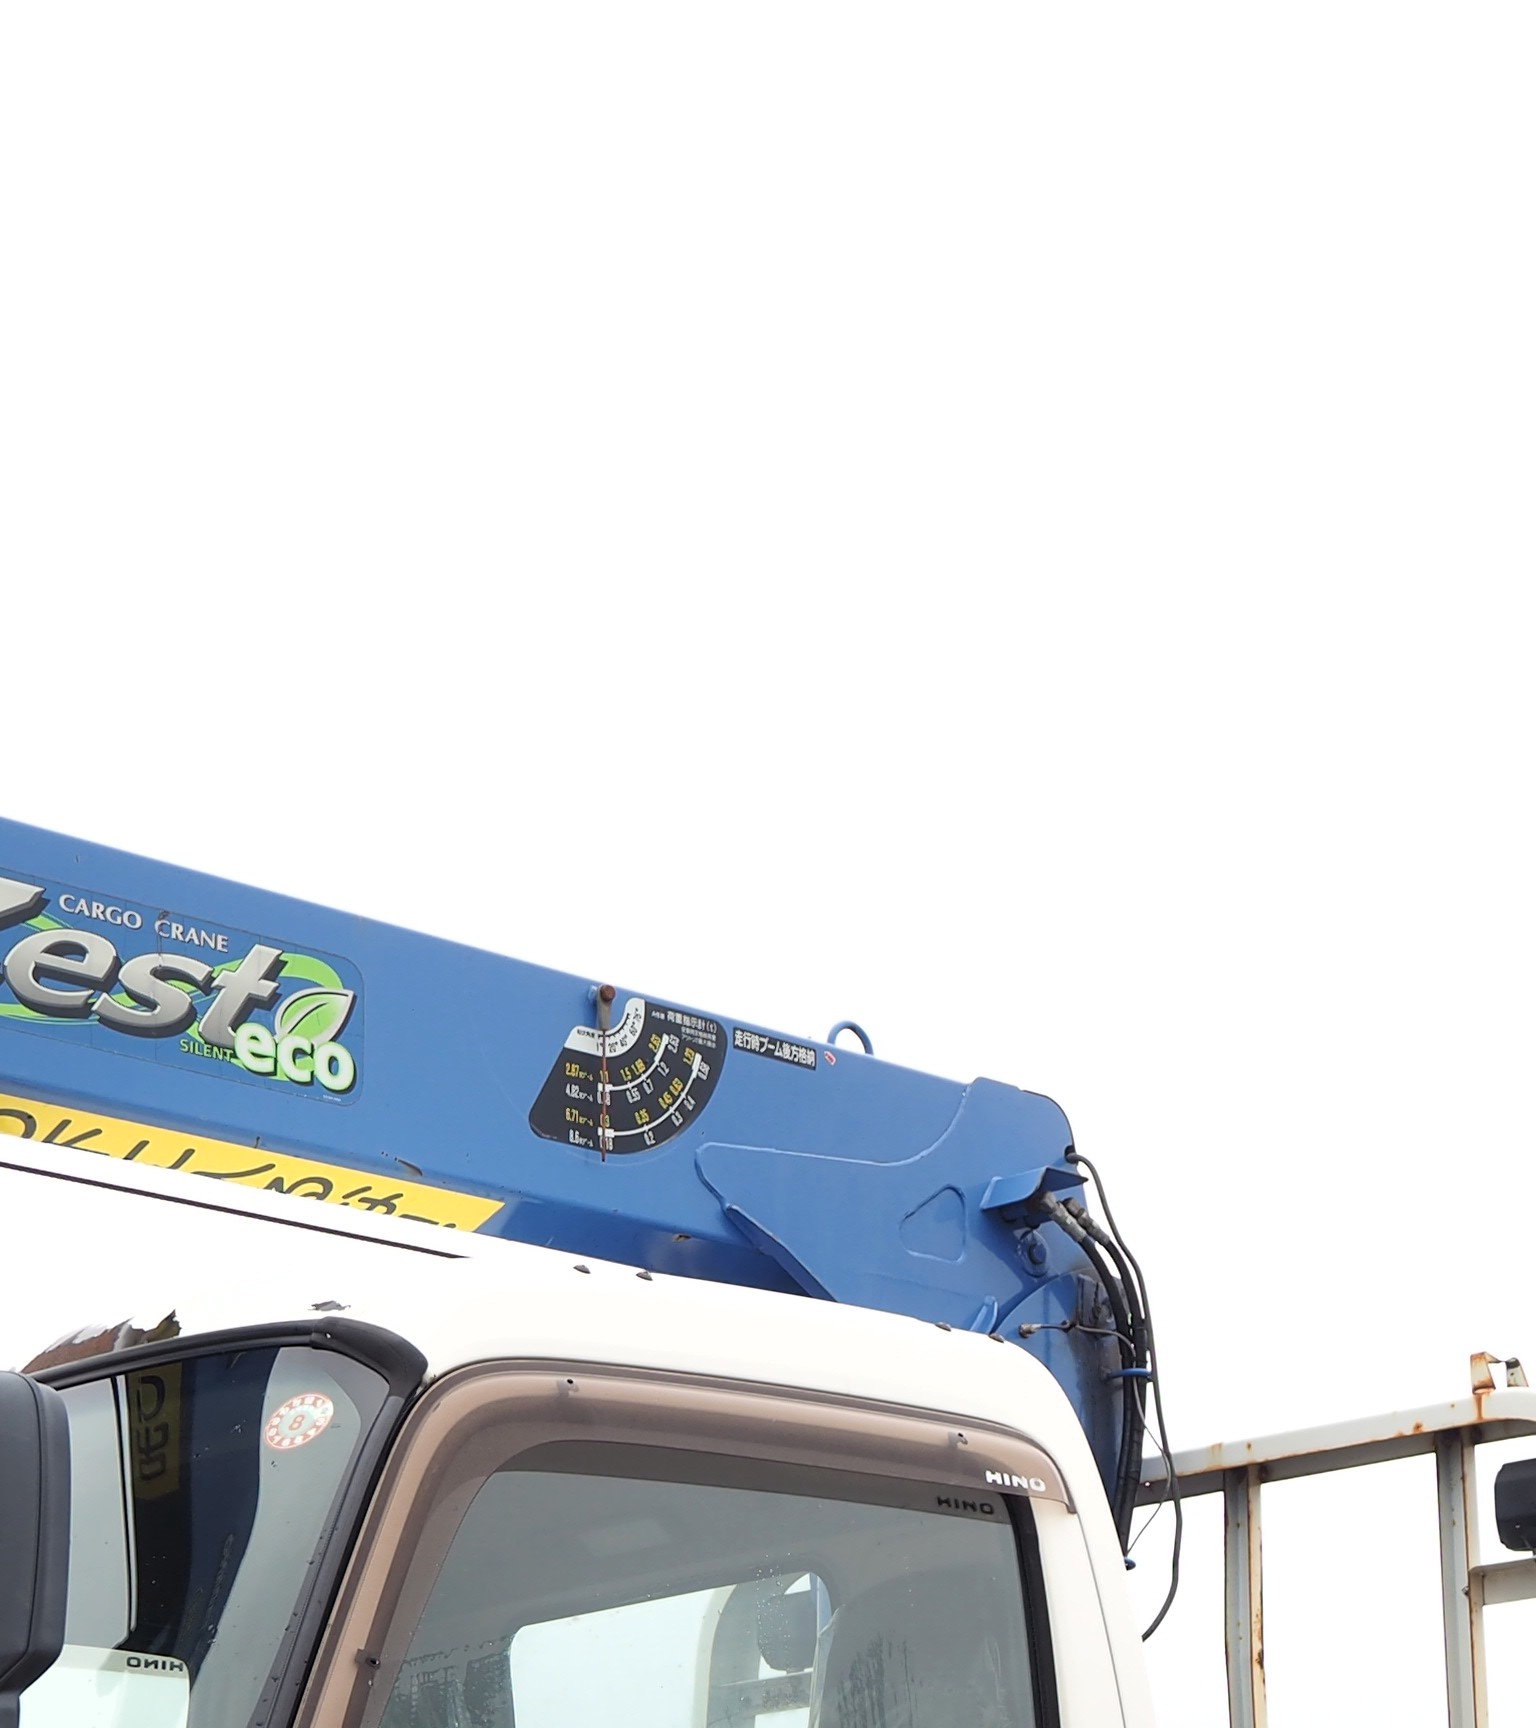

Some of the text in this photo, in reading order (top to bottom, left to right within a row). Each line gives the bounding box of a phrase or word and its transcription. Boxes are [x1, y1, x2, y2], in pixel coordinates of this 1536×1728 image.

[59, 894, 229, 953] CARGO CRANE
[179, 1022, 357, 1092] SILENT eco
[288, 1414, 306, 1431] 8
[985, 1470, 1046, 1492] HINO
[936, 1496, 995, 1515] HINO
